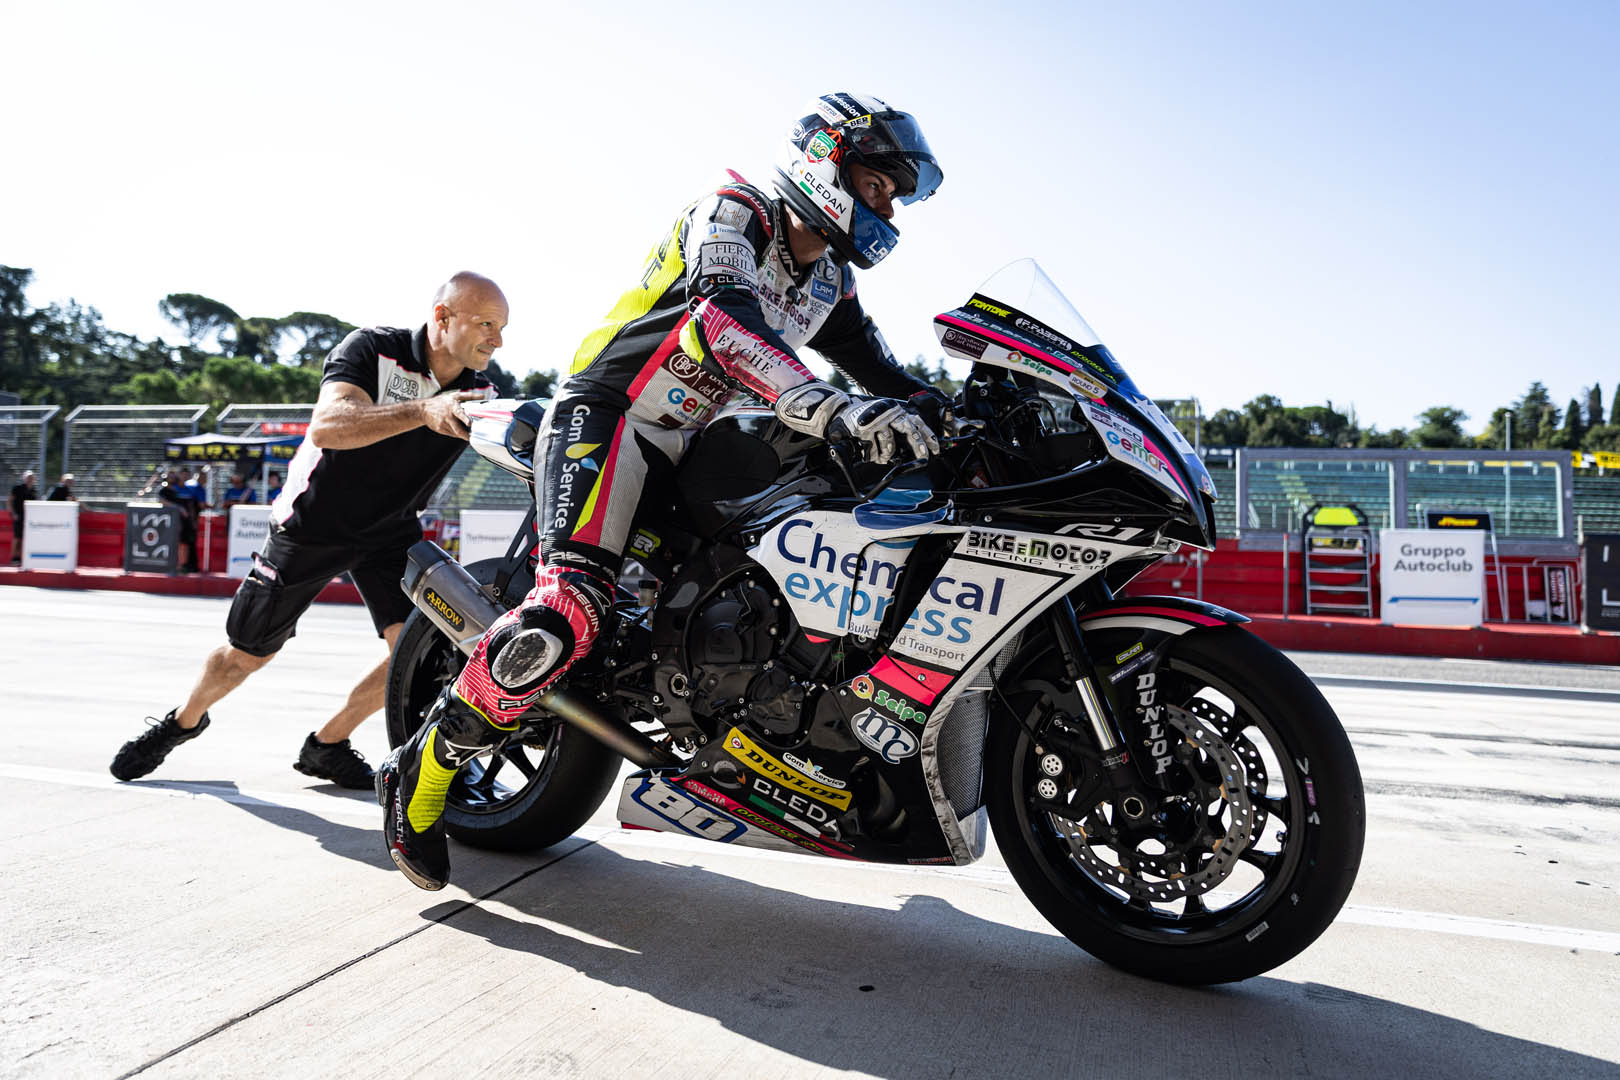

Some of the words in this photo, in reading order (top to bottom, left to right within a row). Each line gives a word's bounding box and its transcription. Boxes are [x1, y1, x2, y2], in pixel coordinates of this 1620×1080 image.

[804, 172, 847, 214] CLEDAN
[715, 244, 752, 260] FIERA
[718, 276, 756, 290] CLEDA
[753, 342, 781, 366] VILLA
[390, 373, 419, 396] DCR
[1072, 377, 1092, 390] ROUND
[1093, 386, 1099, 394] 5
[568, 404, 591, 442] Gom
[1106, 431, 1166, 472] Gemar
[555, 463, 580, 529] Service
[1054, 523, 1145, 541] R1
[777, 518, 1005, 616] Chemcal
[966, 550, 1043, 566] RACING
[1393, 559, 1473, 572] Autoclub
[1400, 544, 1466, 559] Gruppo
[427, 591, 462, 625] ARROW
[565, 584, 600, 632] REWIN
[849, 622, 873, 635] Bulk
[908, 637, 966, 662] Transport
[1136, 672, 1173, 774] DUNLOP
[745, 749, 847, 801] DUNLOP
[785, 753, 804, 768] Gom
[813, 771, 845, 786] Service
[687, 780, 726, 806] YAMAHA
[753, 778, 840, 842] CLEDA
